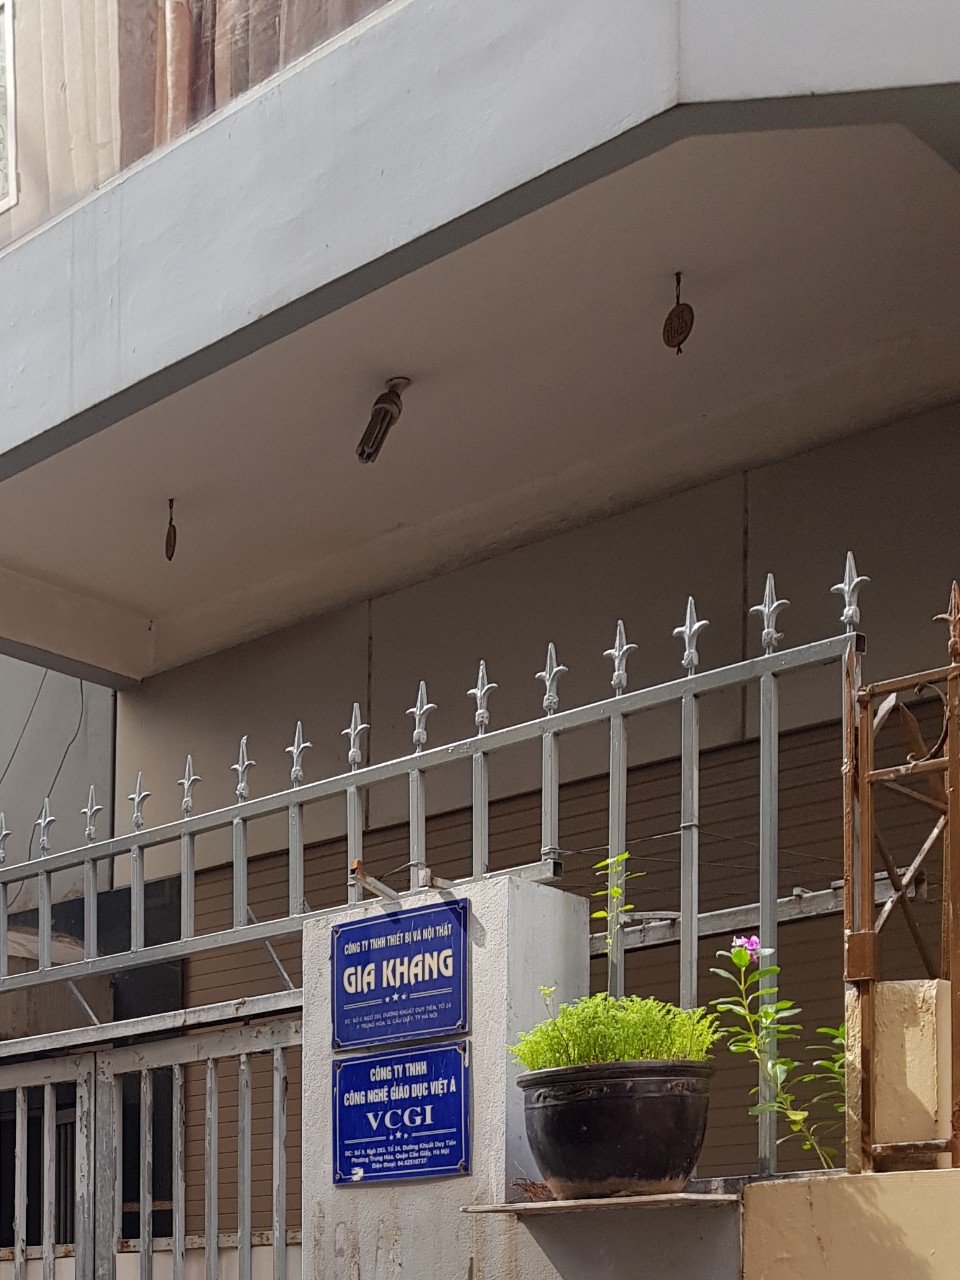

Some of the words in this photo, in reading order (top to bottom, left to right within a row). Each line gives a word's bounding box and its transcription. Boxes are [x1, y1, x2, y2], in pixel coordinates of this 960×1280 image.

[344, 942, 360, 955] CÔNG
[361, 940, 369, 952] TY
[370, 937, 386, 950] TNHH
[387, 930, 403, 946] THIẾT
[422, 925, 435, 941] NỘI
[343, 962, 375, 994] GIA
[382, 948, 453, 989] KHANG
[370, 1065, 392, 1081] CÔNG
[393, 1064, 403, 1078] TY
[405, 1061, 427, 1076] TNHH
[344, 1090, 365, 1106] CÔNG
[367, 1085, 389, 1104] NGHỆ
[390, 1083, 409, 1100] GIÁO
[411, 1082, 428, 1099] DỤC
[430, 1078, 448, 1097] VIỆT
[366, 1104, 434, 1131] VCGI
